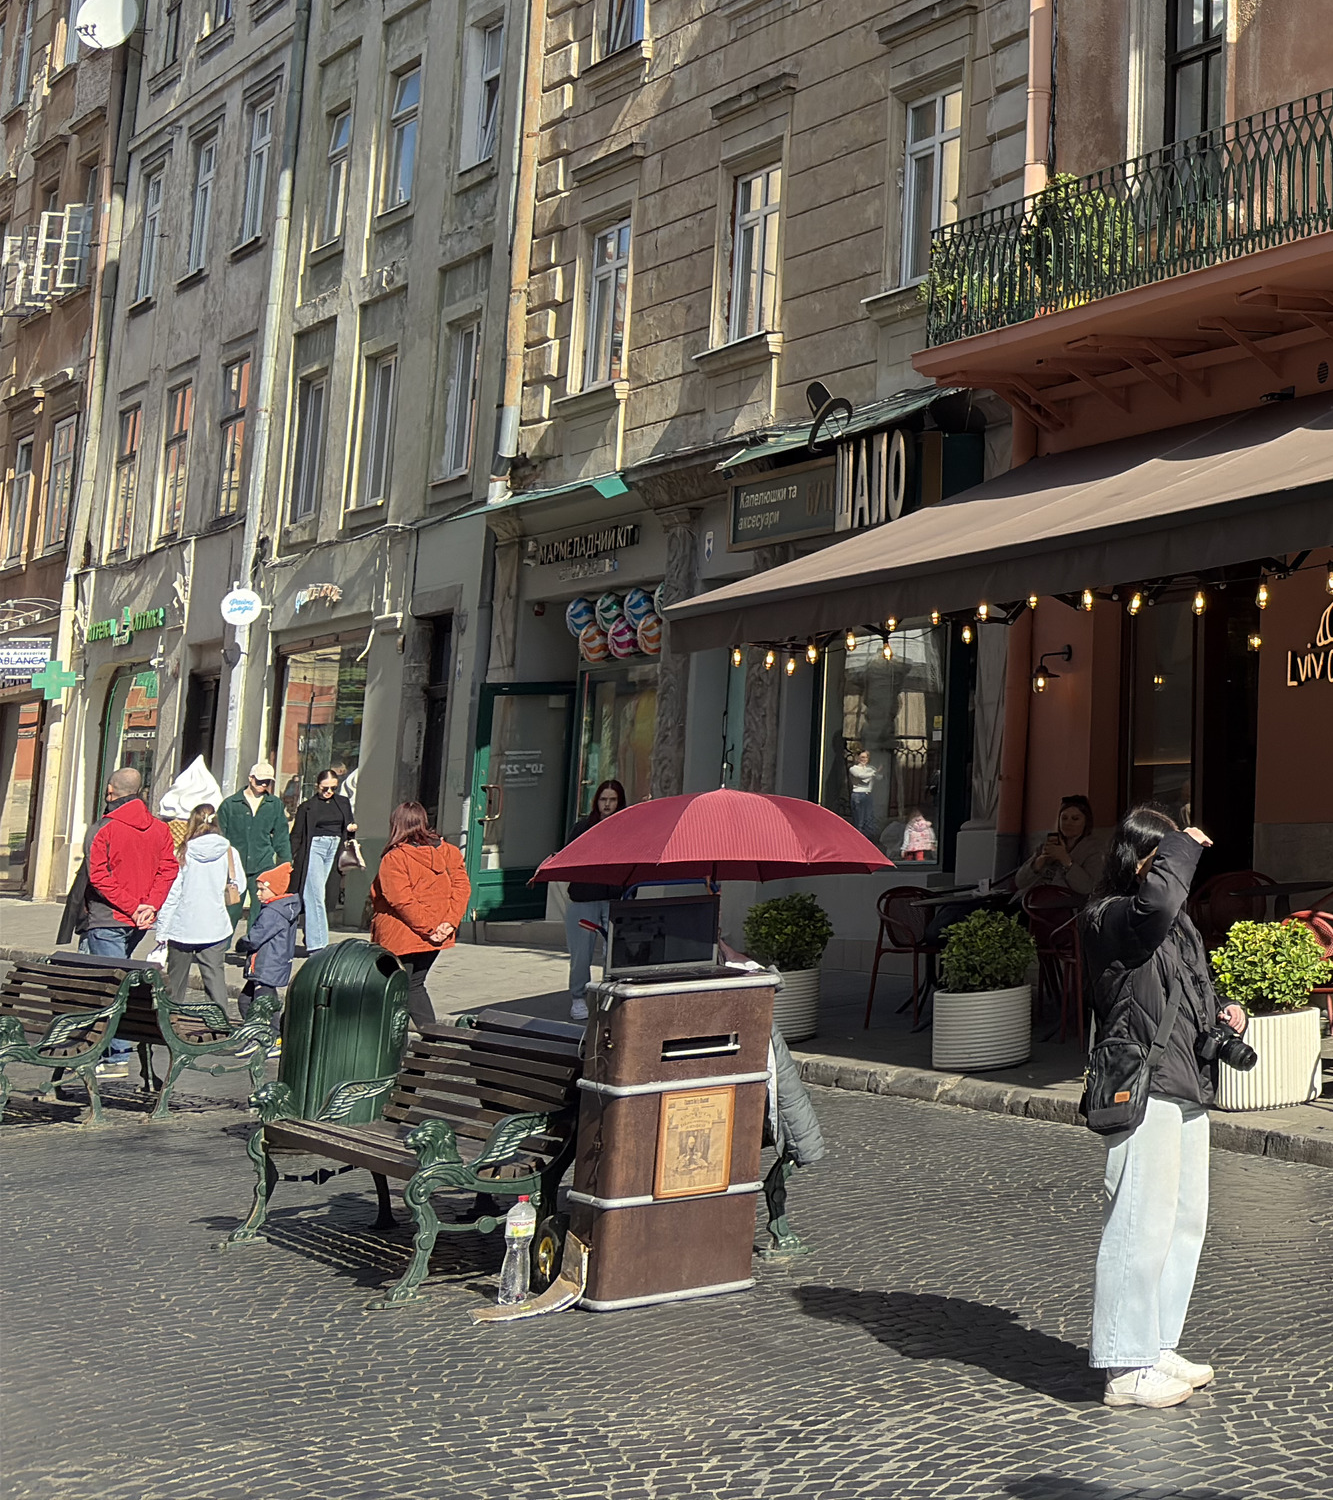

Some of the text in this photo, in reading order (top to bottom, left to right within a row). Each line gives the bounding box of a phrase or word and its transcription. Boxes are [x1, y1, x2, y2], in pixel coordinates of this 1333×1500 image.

[834, 429, 906, 533] ШАПО
[738, 483, 798, 509] Капелюшки та
[737, 509, 780, 533] аксесуари
